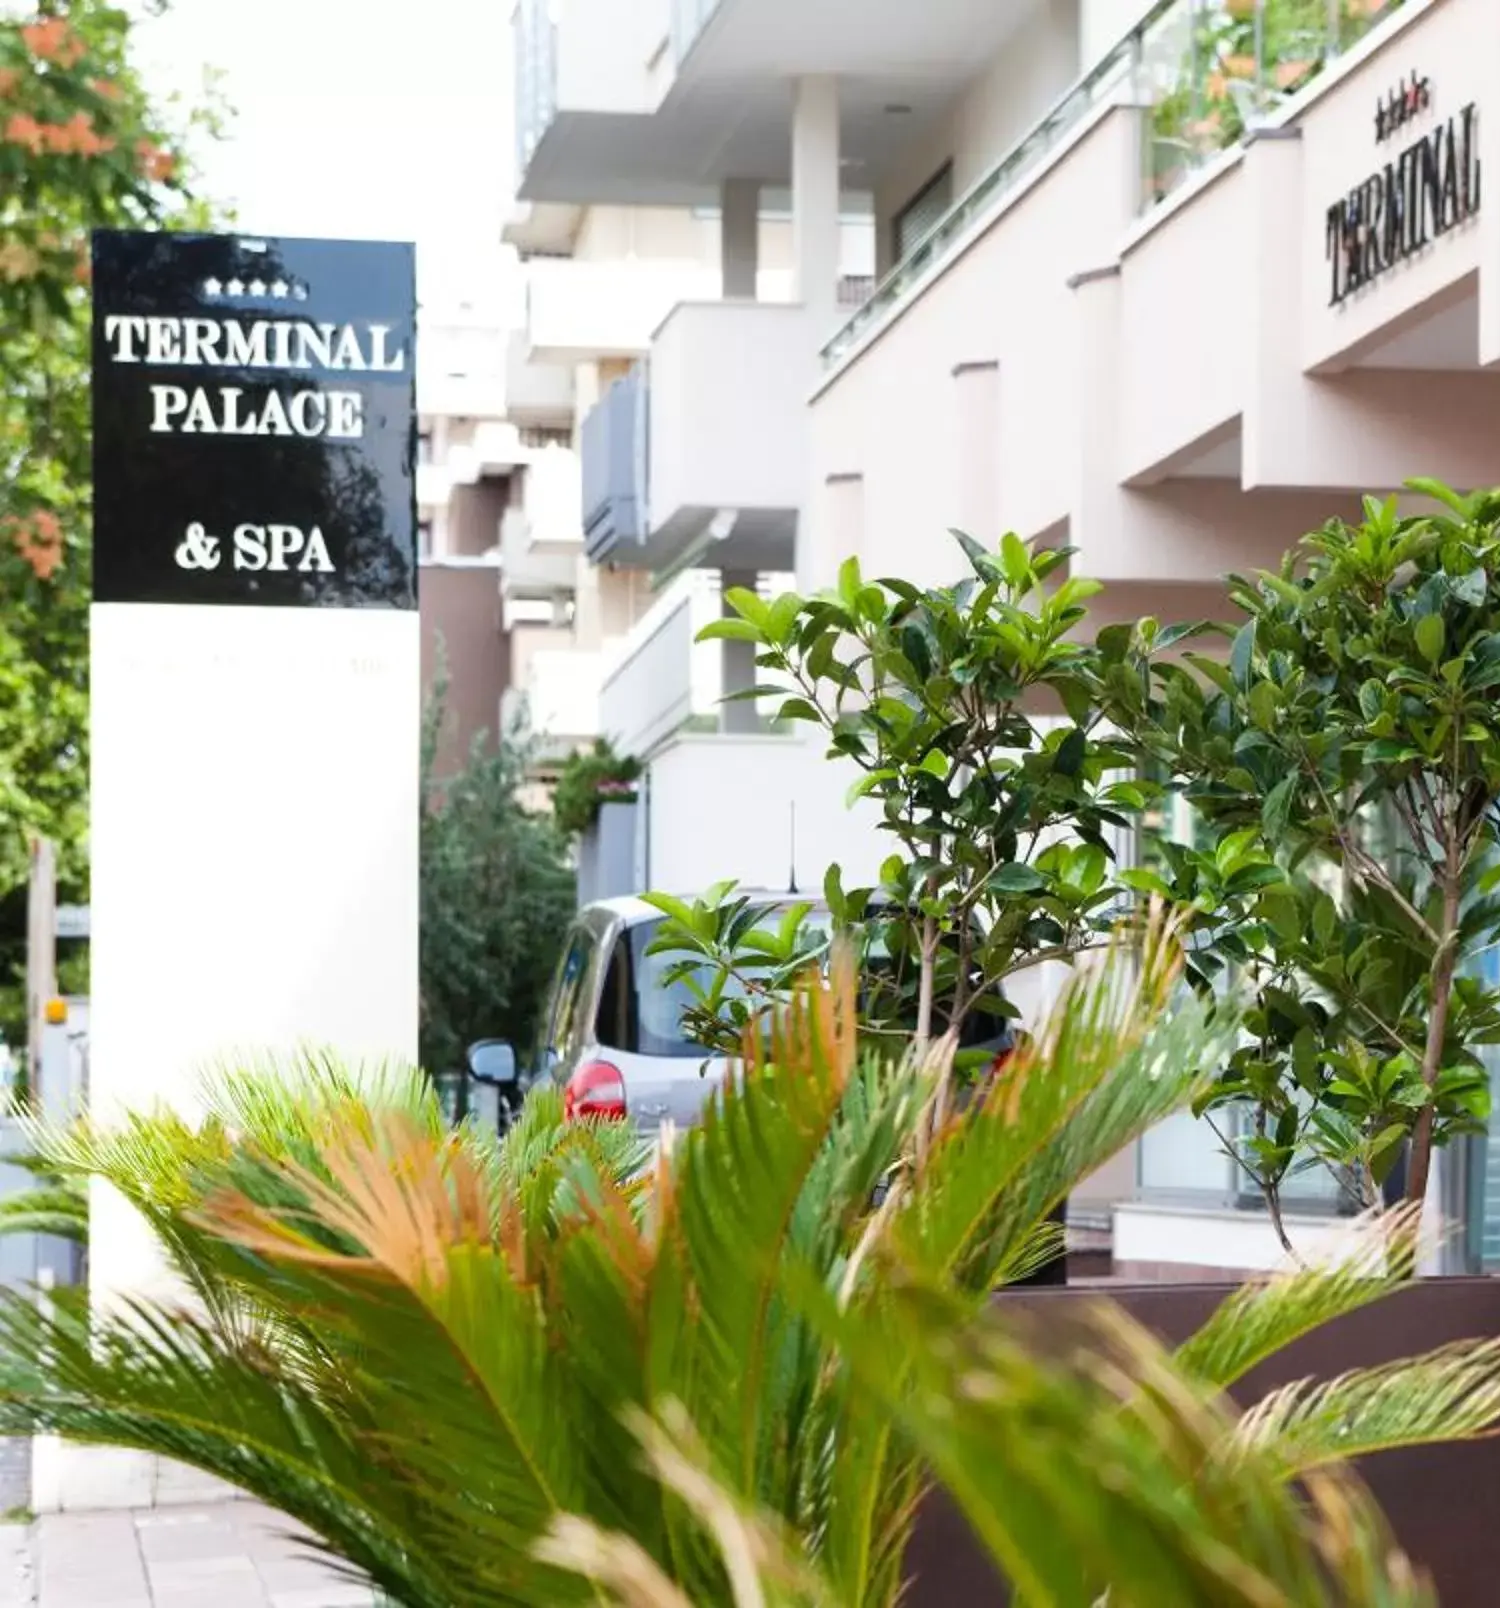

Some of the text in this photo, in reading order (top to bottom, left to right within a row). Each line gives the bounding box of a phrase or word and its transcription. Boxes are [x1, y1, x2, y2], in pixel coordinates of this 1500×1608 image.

[1326, 102, 1481, 306] TERMINAL
[105, 315, 405, 372] TERMINAL
[149, 385, 364, 438] PALACE
[174, 521, 336, 573] & SPA
